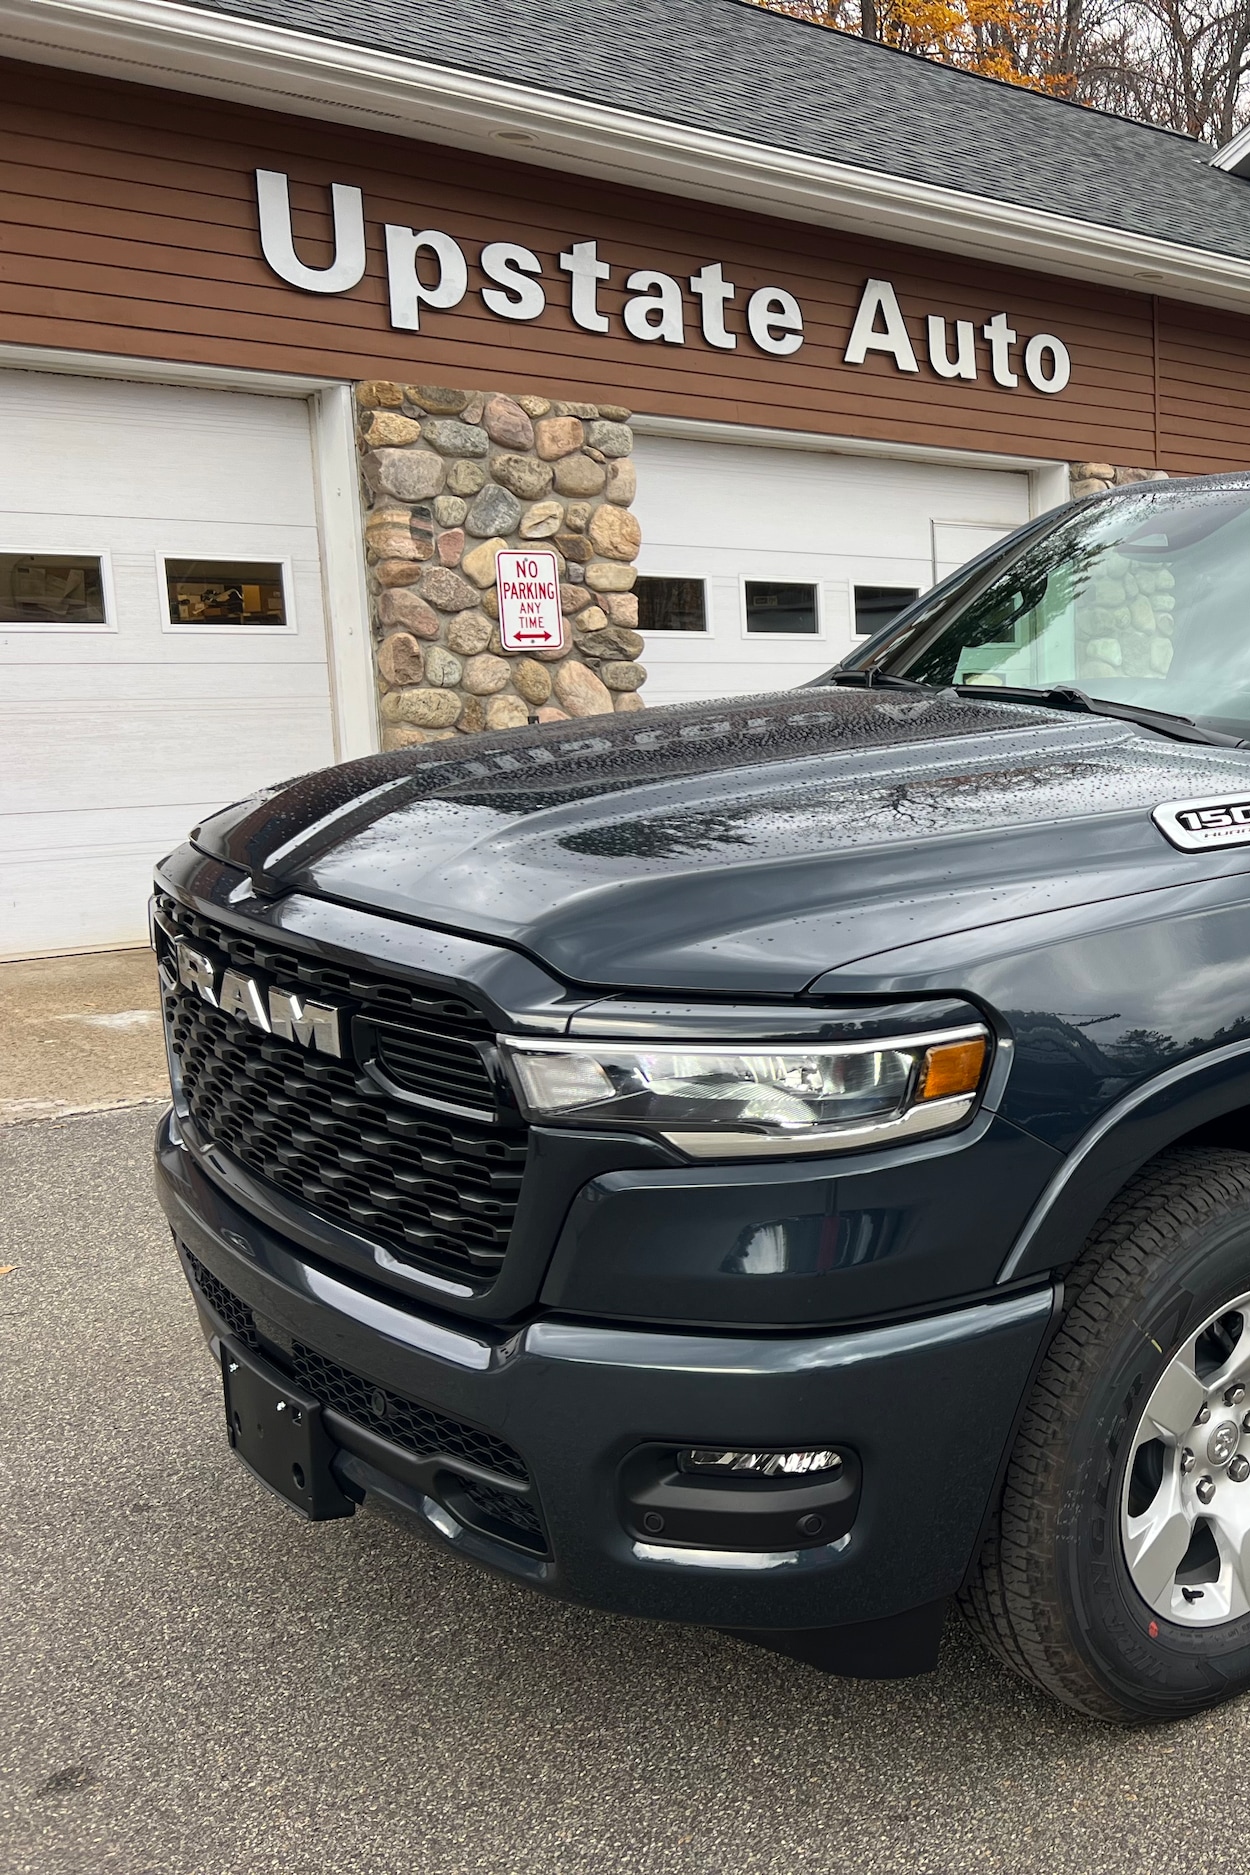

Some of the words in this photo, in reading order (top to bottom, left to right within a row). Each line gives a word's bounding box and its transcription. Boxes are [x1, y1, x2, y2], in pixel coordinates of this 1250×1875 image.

[255, 167, 804, 356] Upstate
[843, 277, 1073, 395] Auto
[516, 560, 538, 578] NO
[503, 582, 555, 600] PARKING
[519, 602, 541, 614] ANY
[518, 616, 545, 628] TIME
[176, 935, 342, 1059] RAM
